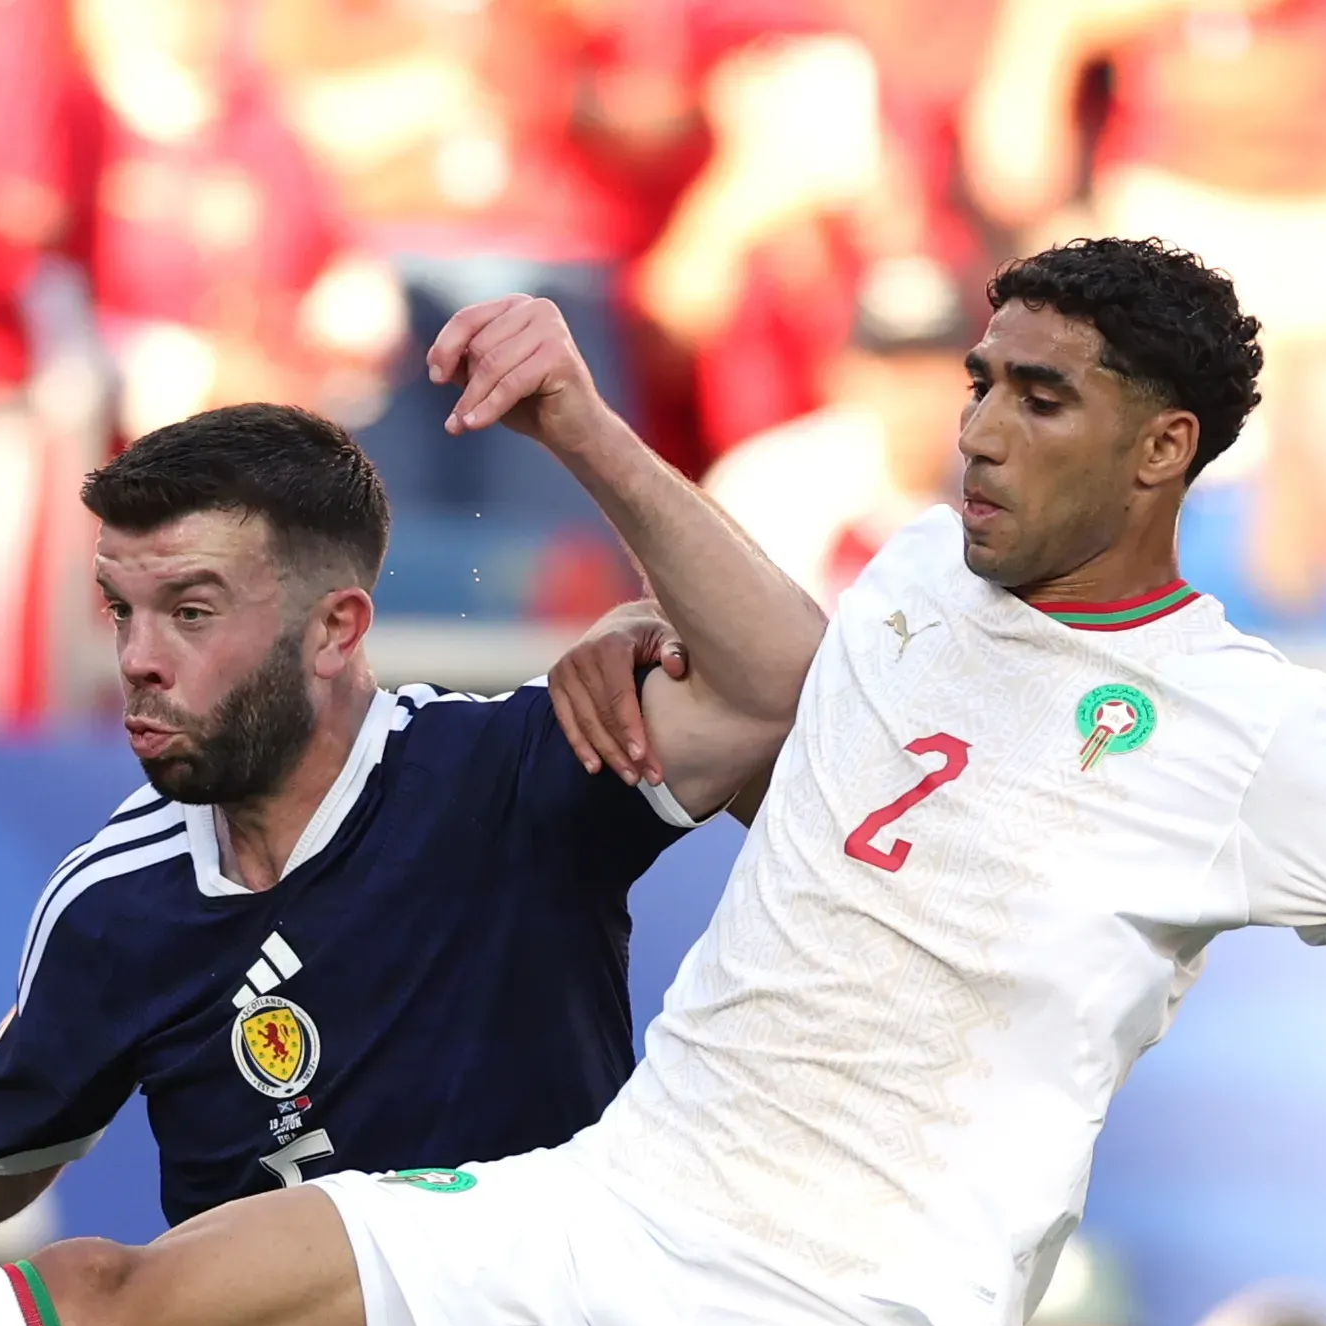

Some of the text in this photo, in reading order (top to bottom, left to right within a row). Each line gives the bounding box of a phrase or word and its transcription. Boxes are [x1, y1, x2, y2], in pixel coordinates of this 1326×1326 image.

[844, 732, 974, 873] 2
[243, 998, 283, 1017] SCOTLAND
[304, 1062, 315, 1080] 1873
[257, 1082, 270, 1093] EST
[269, 1118, 278, 1130] 19
